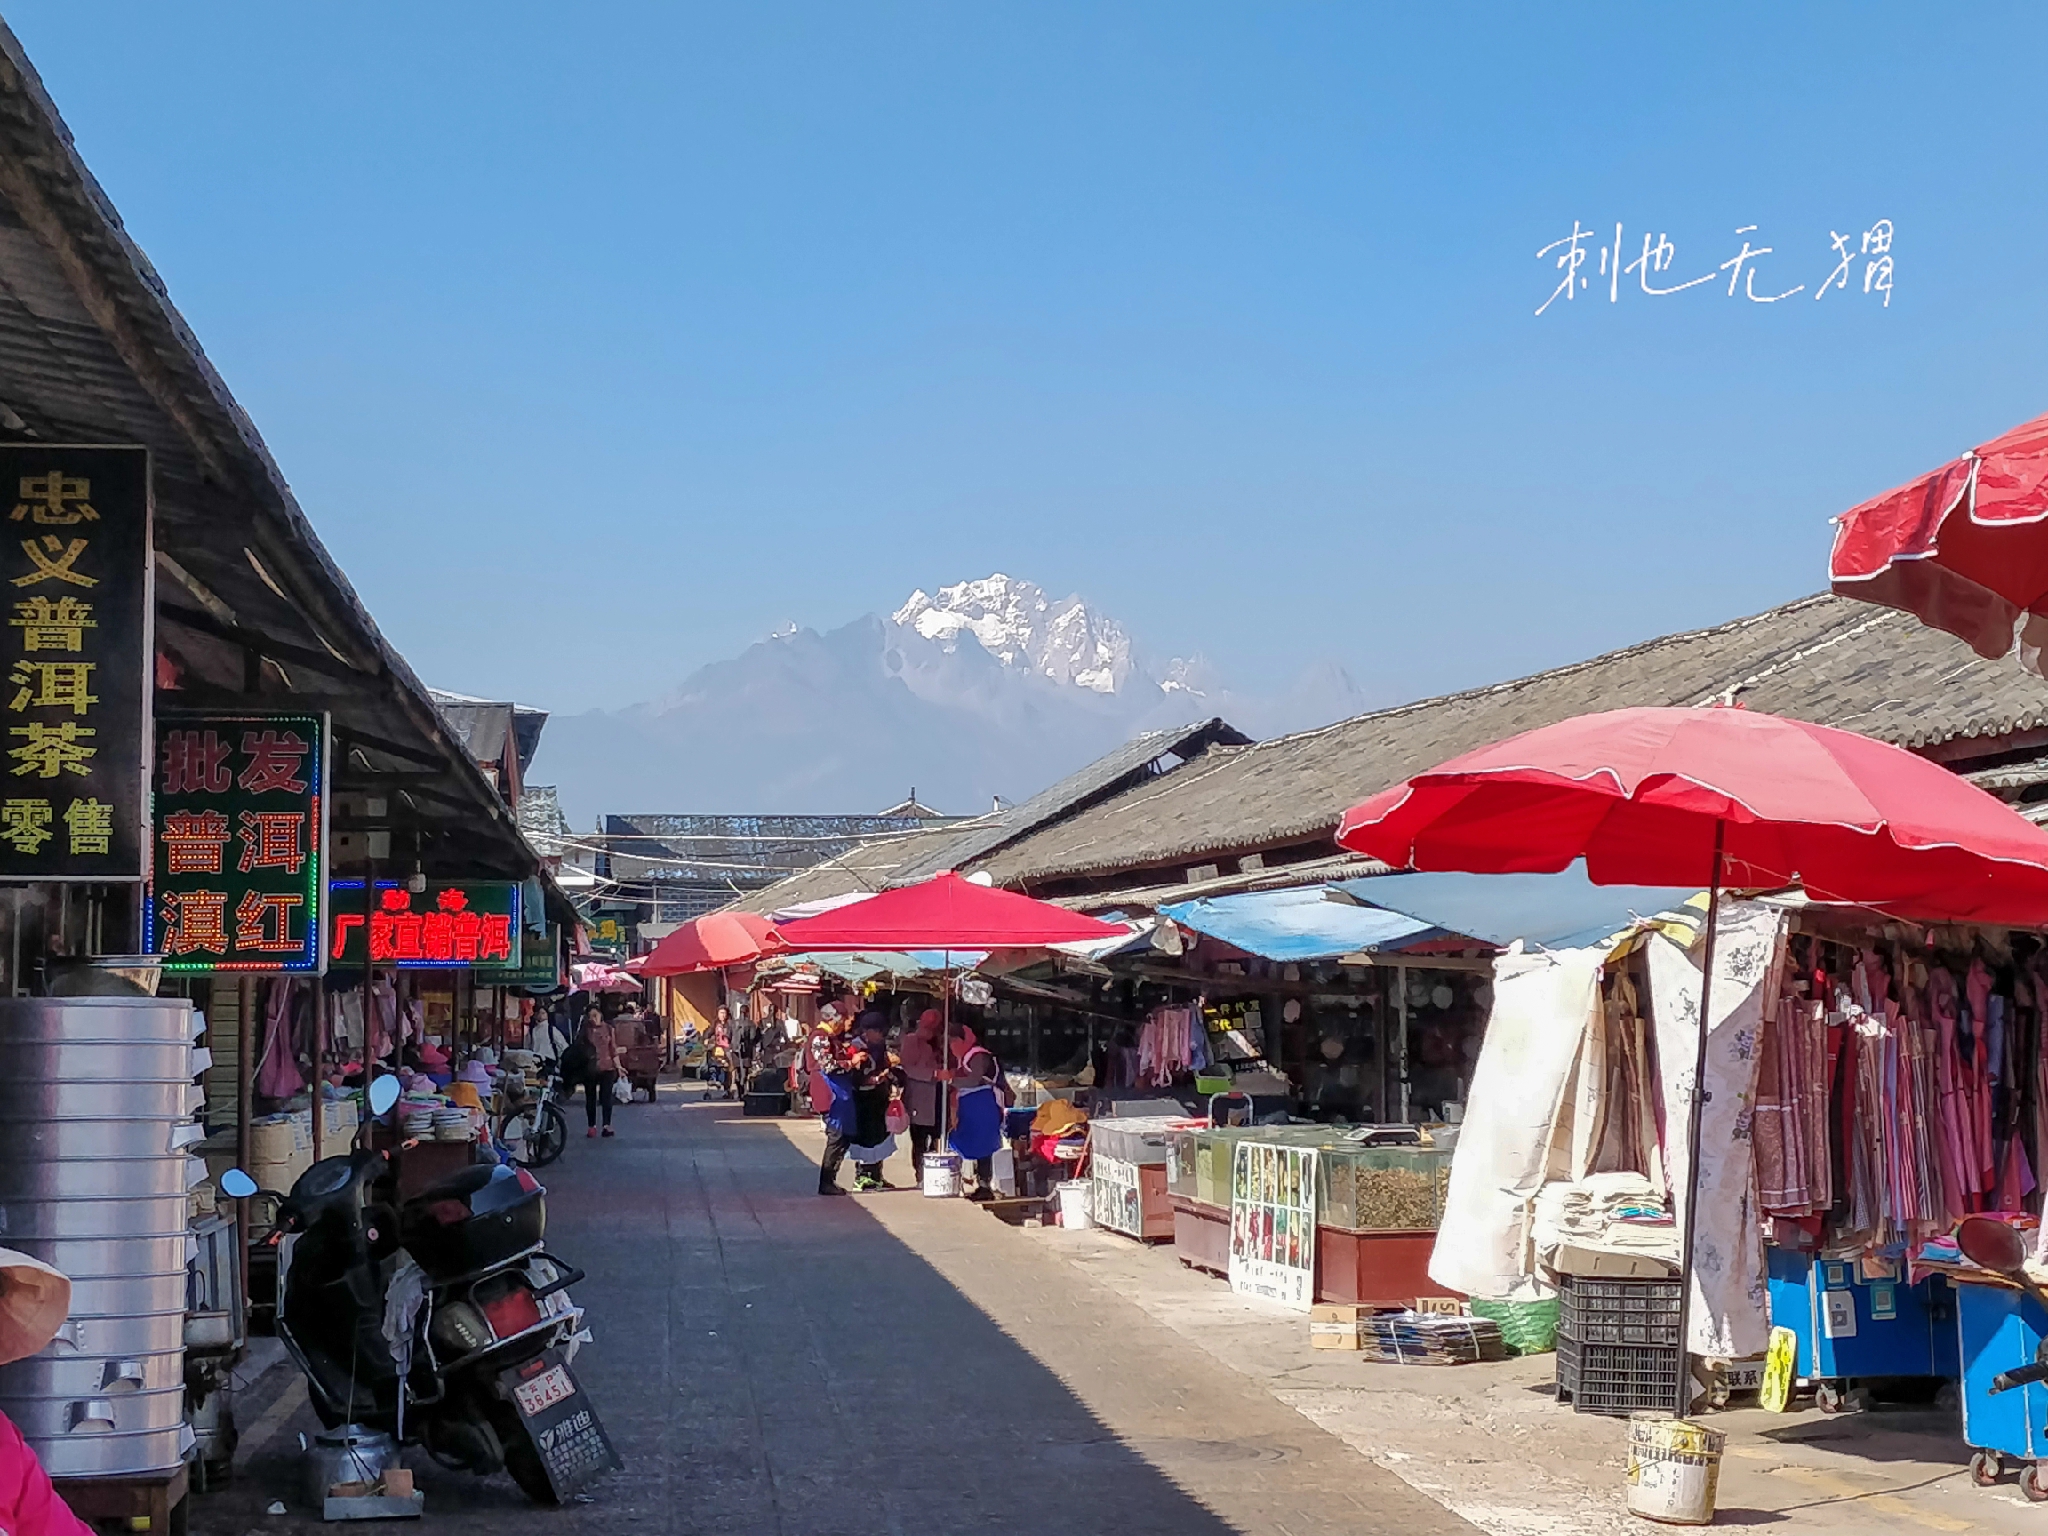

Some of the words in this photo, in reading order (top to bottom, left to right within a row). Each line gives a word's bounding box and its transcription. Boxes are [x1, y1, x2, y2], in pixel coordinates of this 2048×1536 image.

[8, 470, 100, 779] 忠义普洱茶
[162, 730, 309, 794] 批发
[1, 797, 114, 855] 零售
[161, 809, 305, 874] 普洱
[159, 889, 305, 955] 滇红
[331, 911, 512, 960] 厂家直销普洱
[555, 1409, 593, 1443] 雅迪
